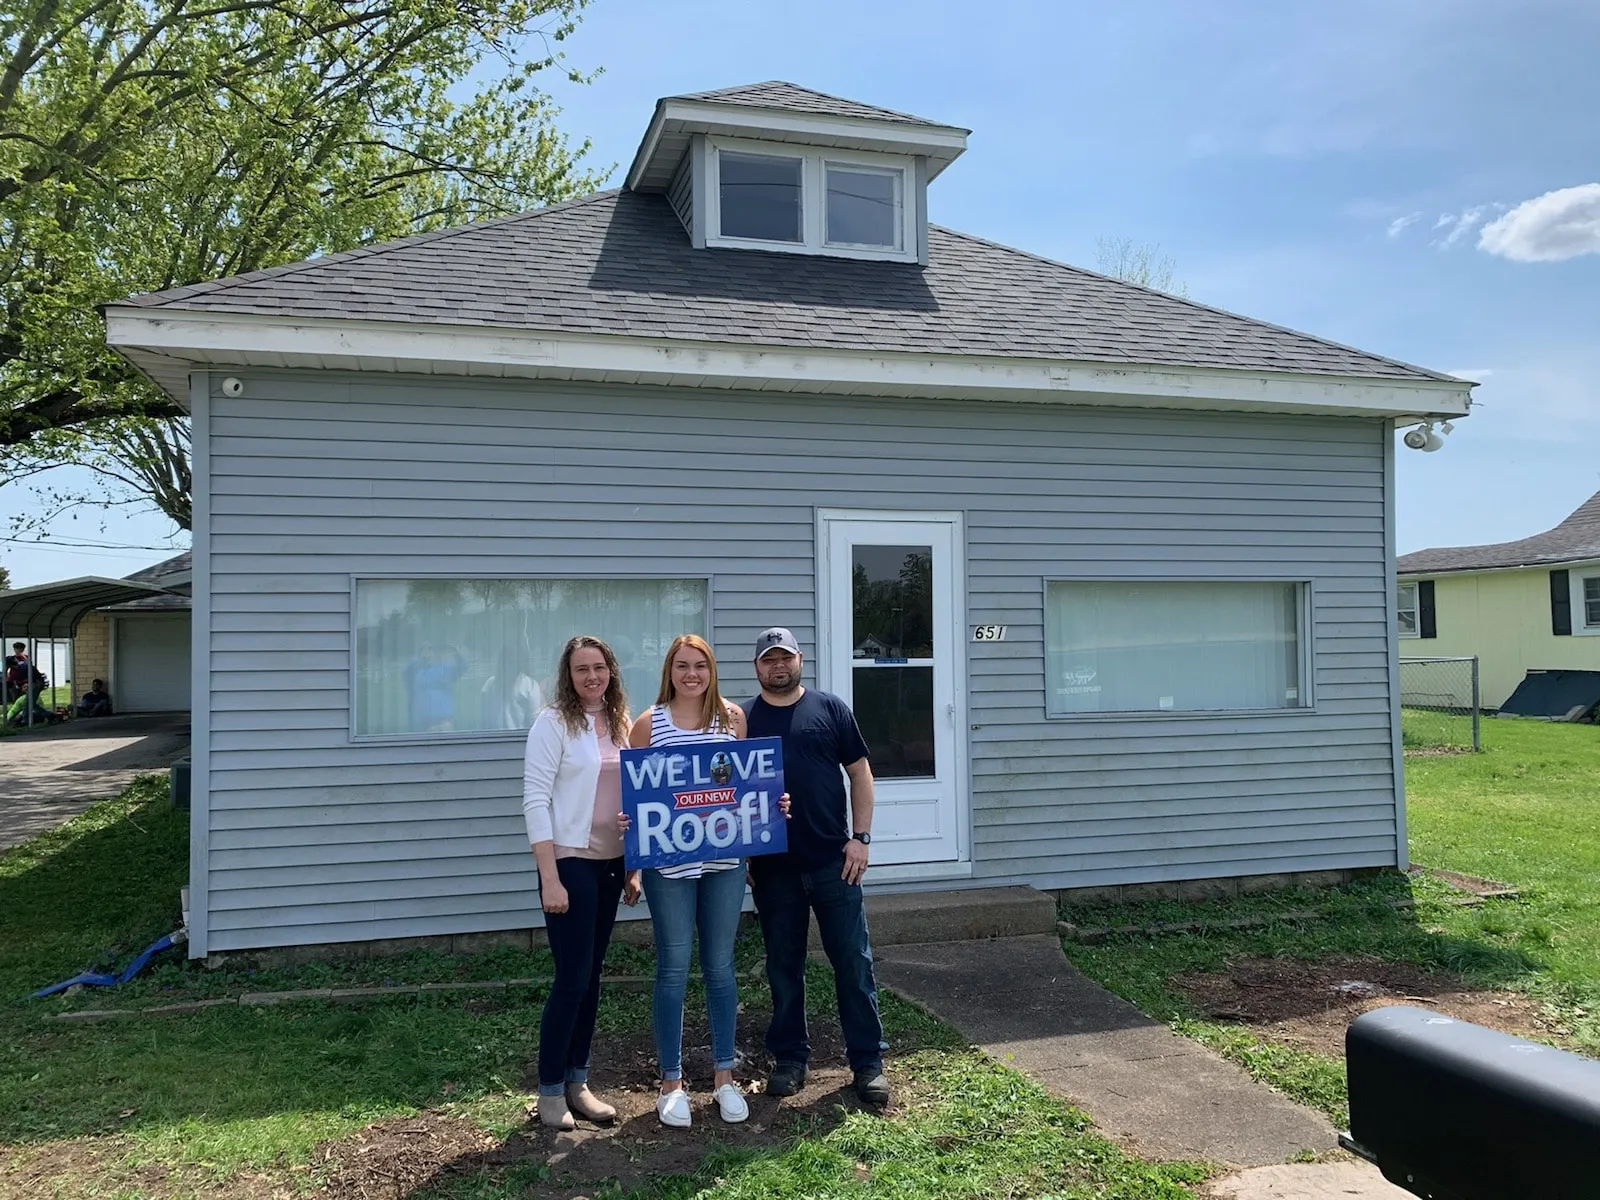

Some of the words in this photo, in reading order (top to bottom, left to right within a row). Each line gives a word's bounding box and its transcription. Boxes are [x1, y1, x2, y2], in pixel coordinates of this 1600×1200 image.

[975, 626, 1003, 640] 651
[625, 756, 687, 790] WE
[679, 795, 704, 805] OUR
[705, 791, 731, 803] NEW
[637, 791, 772, 857] Roof!
